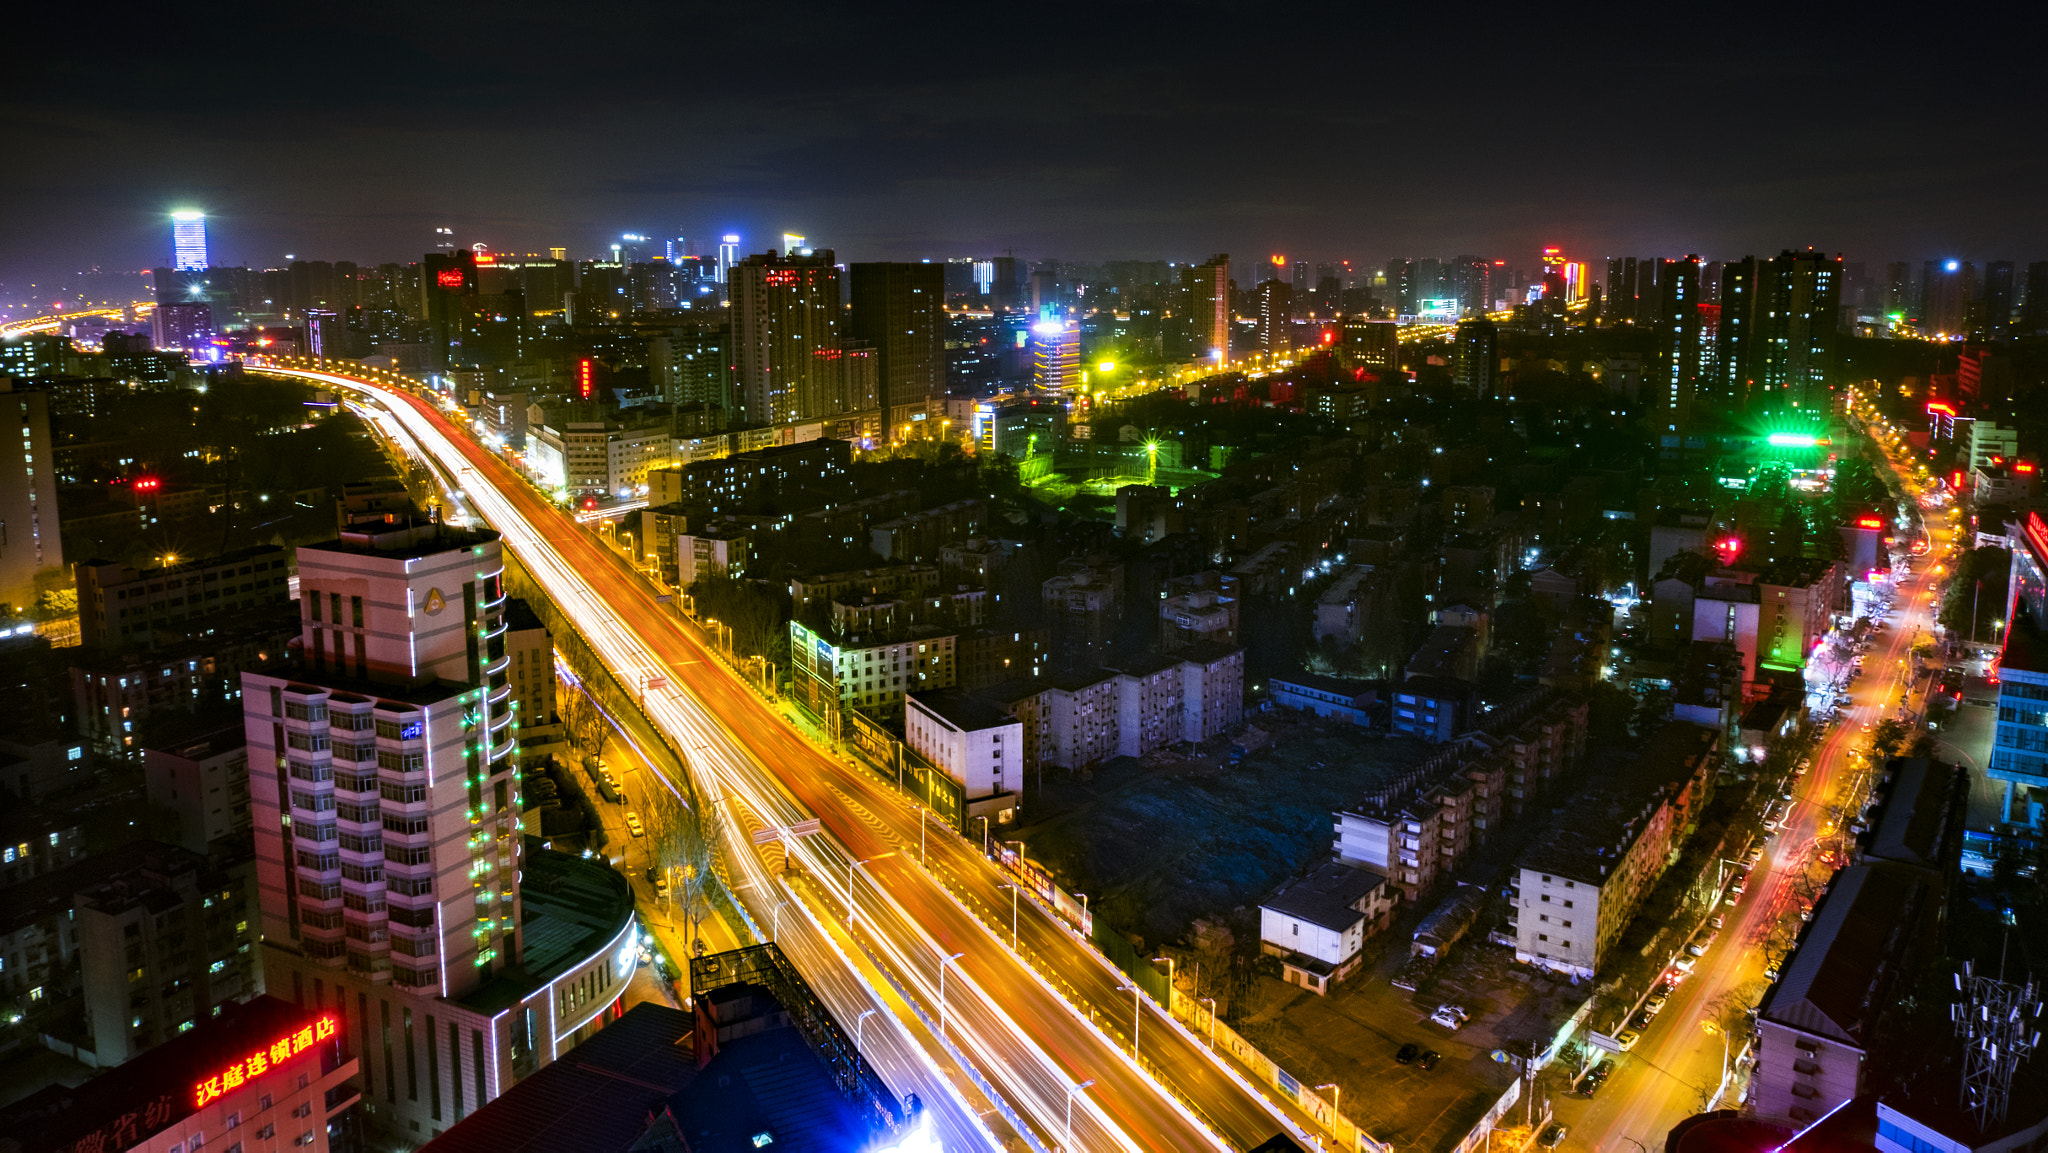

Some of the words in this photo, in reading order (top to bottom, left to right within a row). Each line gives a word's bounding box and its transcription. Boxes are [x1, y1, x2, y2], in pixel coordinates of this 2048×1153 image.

[195, 1016, 335, 1106] 汉庭连锁酒店
